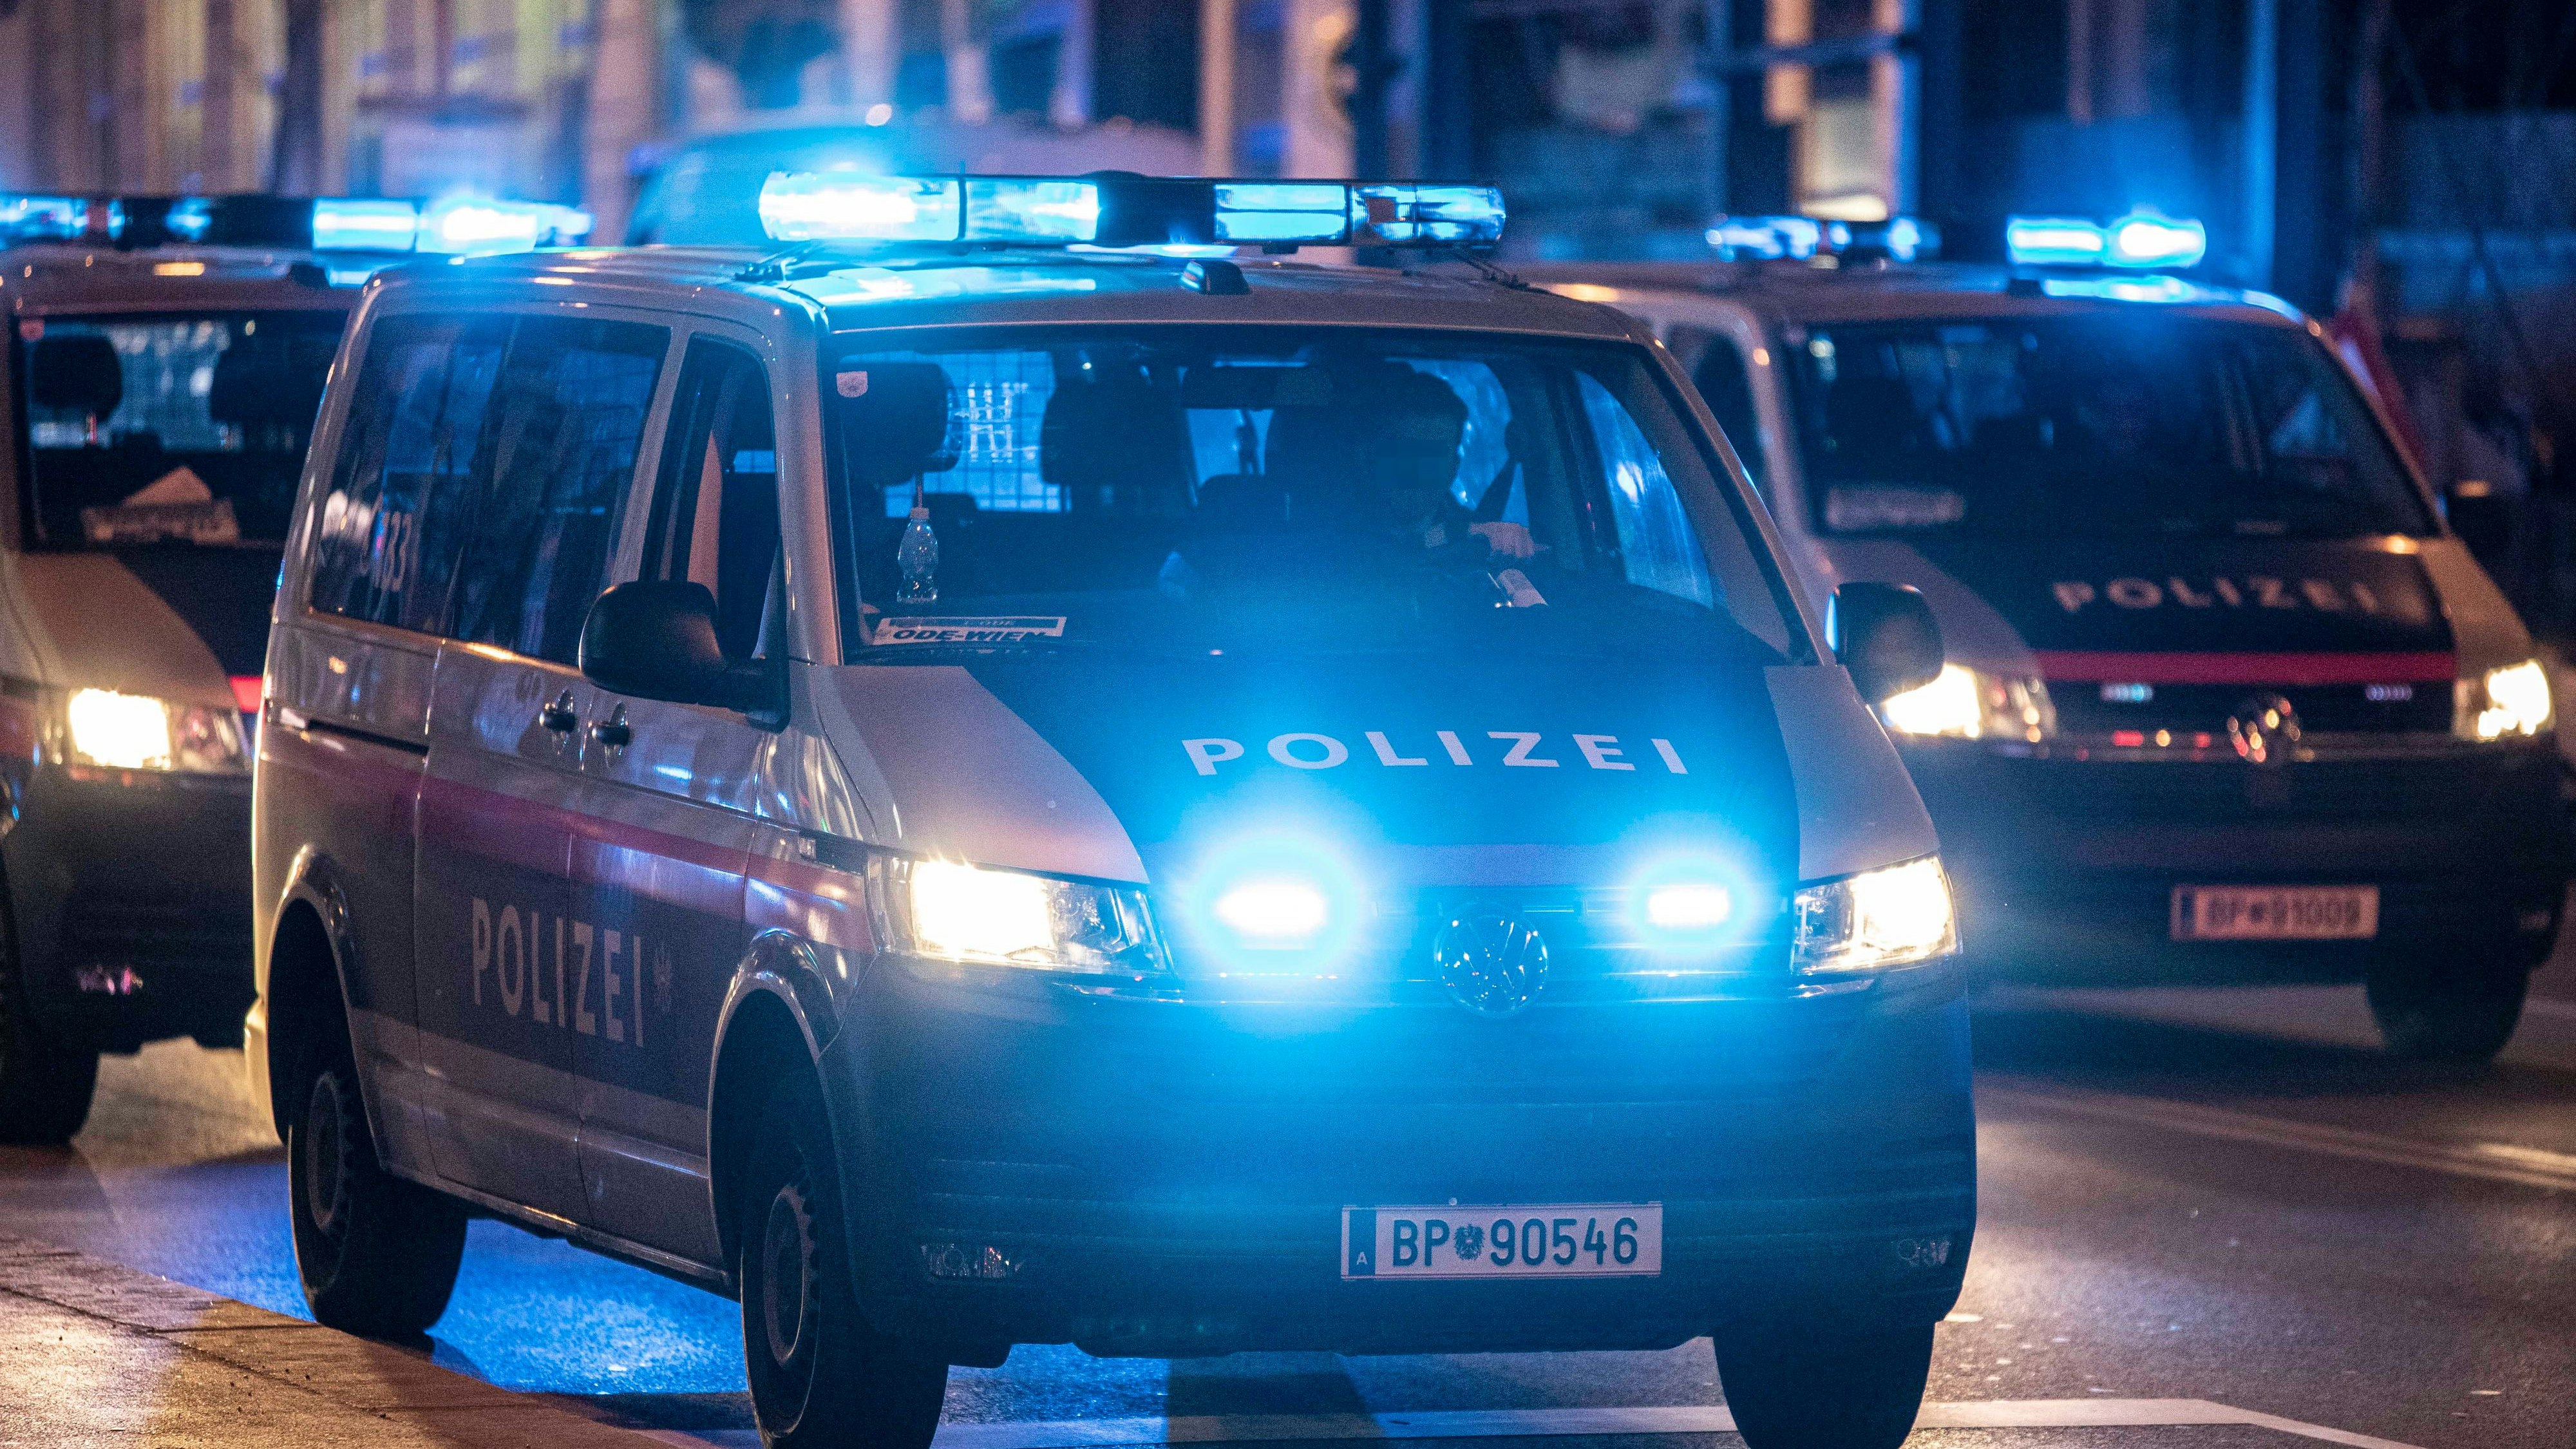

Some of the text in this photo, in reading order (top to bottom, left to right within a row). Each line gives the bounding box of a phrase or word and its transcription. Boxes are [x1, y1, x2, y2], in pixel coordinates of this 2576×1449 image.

[2052, 576, 2381, 614] POLIZEI
[1182, 730, 1688, 775] POLIZEI
[472, 898, 643, 1048] POLIZEI
[1356, 1217, 1638, 1267] A BP 90546
